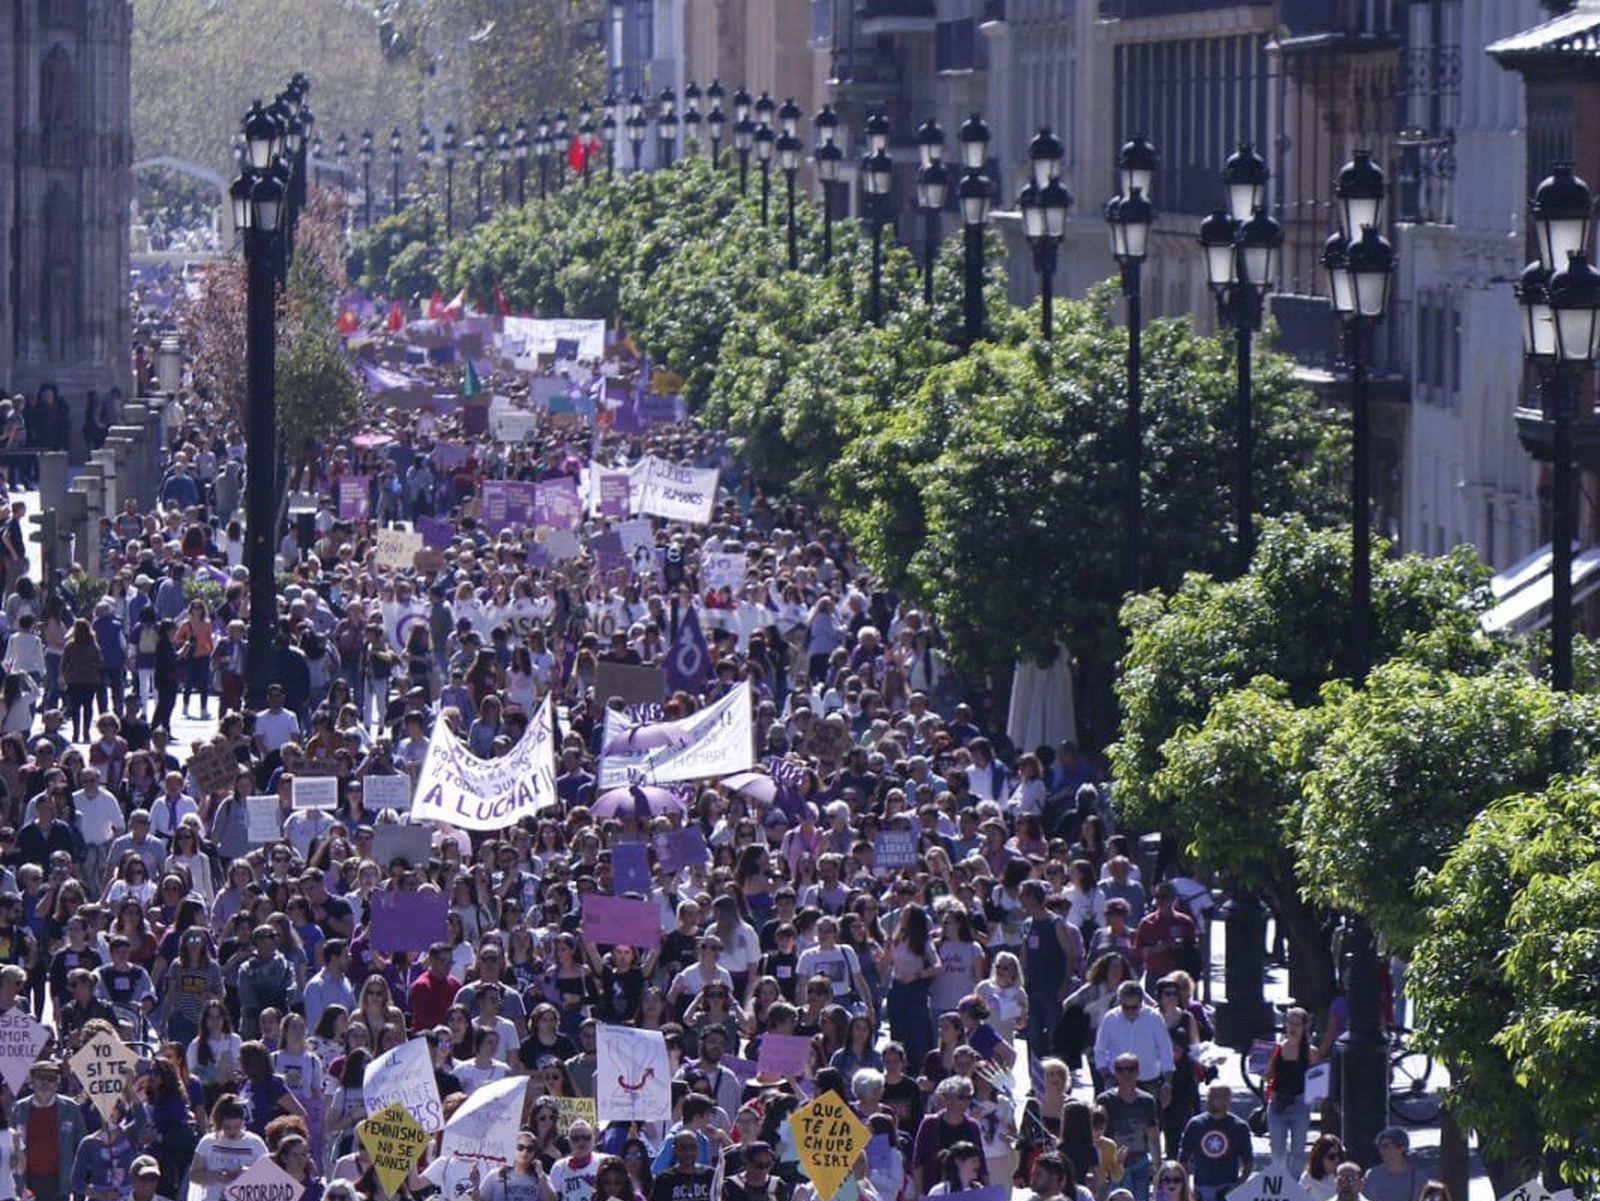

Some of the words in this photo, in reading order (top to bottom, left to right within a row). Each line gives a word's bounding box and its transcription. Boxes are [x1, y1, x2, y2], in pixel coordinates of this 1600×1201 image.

[423, 783, 443, 806] A
[0, 1030, 31, 1042] MOR
[92, 1044, 111, 1058] YO
[87, 1062, 101, 1077] SI
[107, 1061, 127, 1075] TE
[89, 1079, 122, 1095] CREO
[385, 1109, 404, 1121] SIN
[812, 1102, 842, 1119] QUE
[364, 1120, 424, 1143] FEMINISMO
[802, 1118, 823, 1134] TE
[829, 1121, 851, 1137] LA
[377, 1140, 393, 1153] NO
[397, 1143, 414, 1157] SE
[804, 1136, 853, 1152] CHUPE
[811, 1153, 849, 1167] SIRI
[1262, 1176, 1283, 1195] NI
